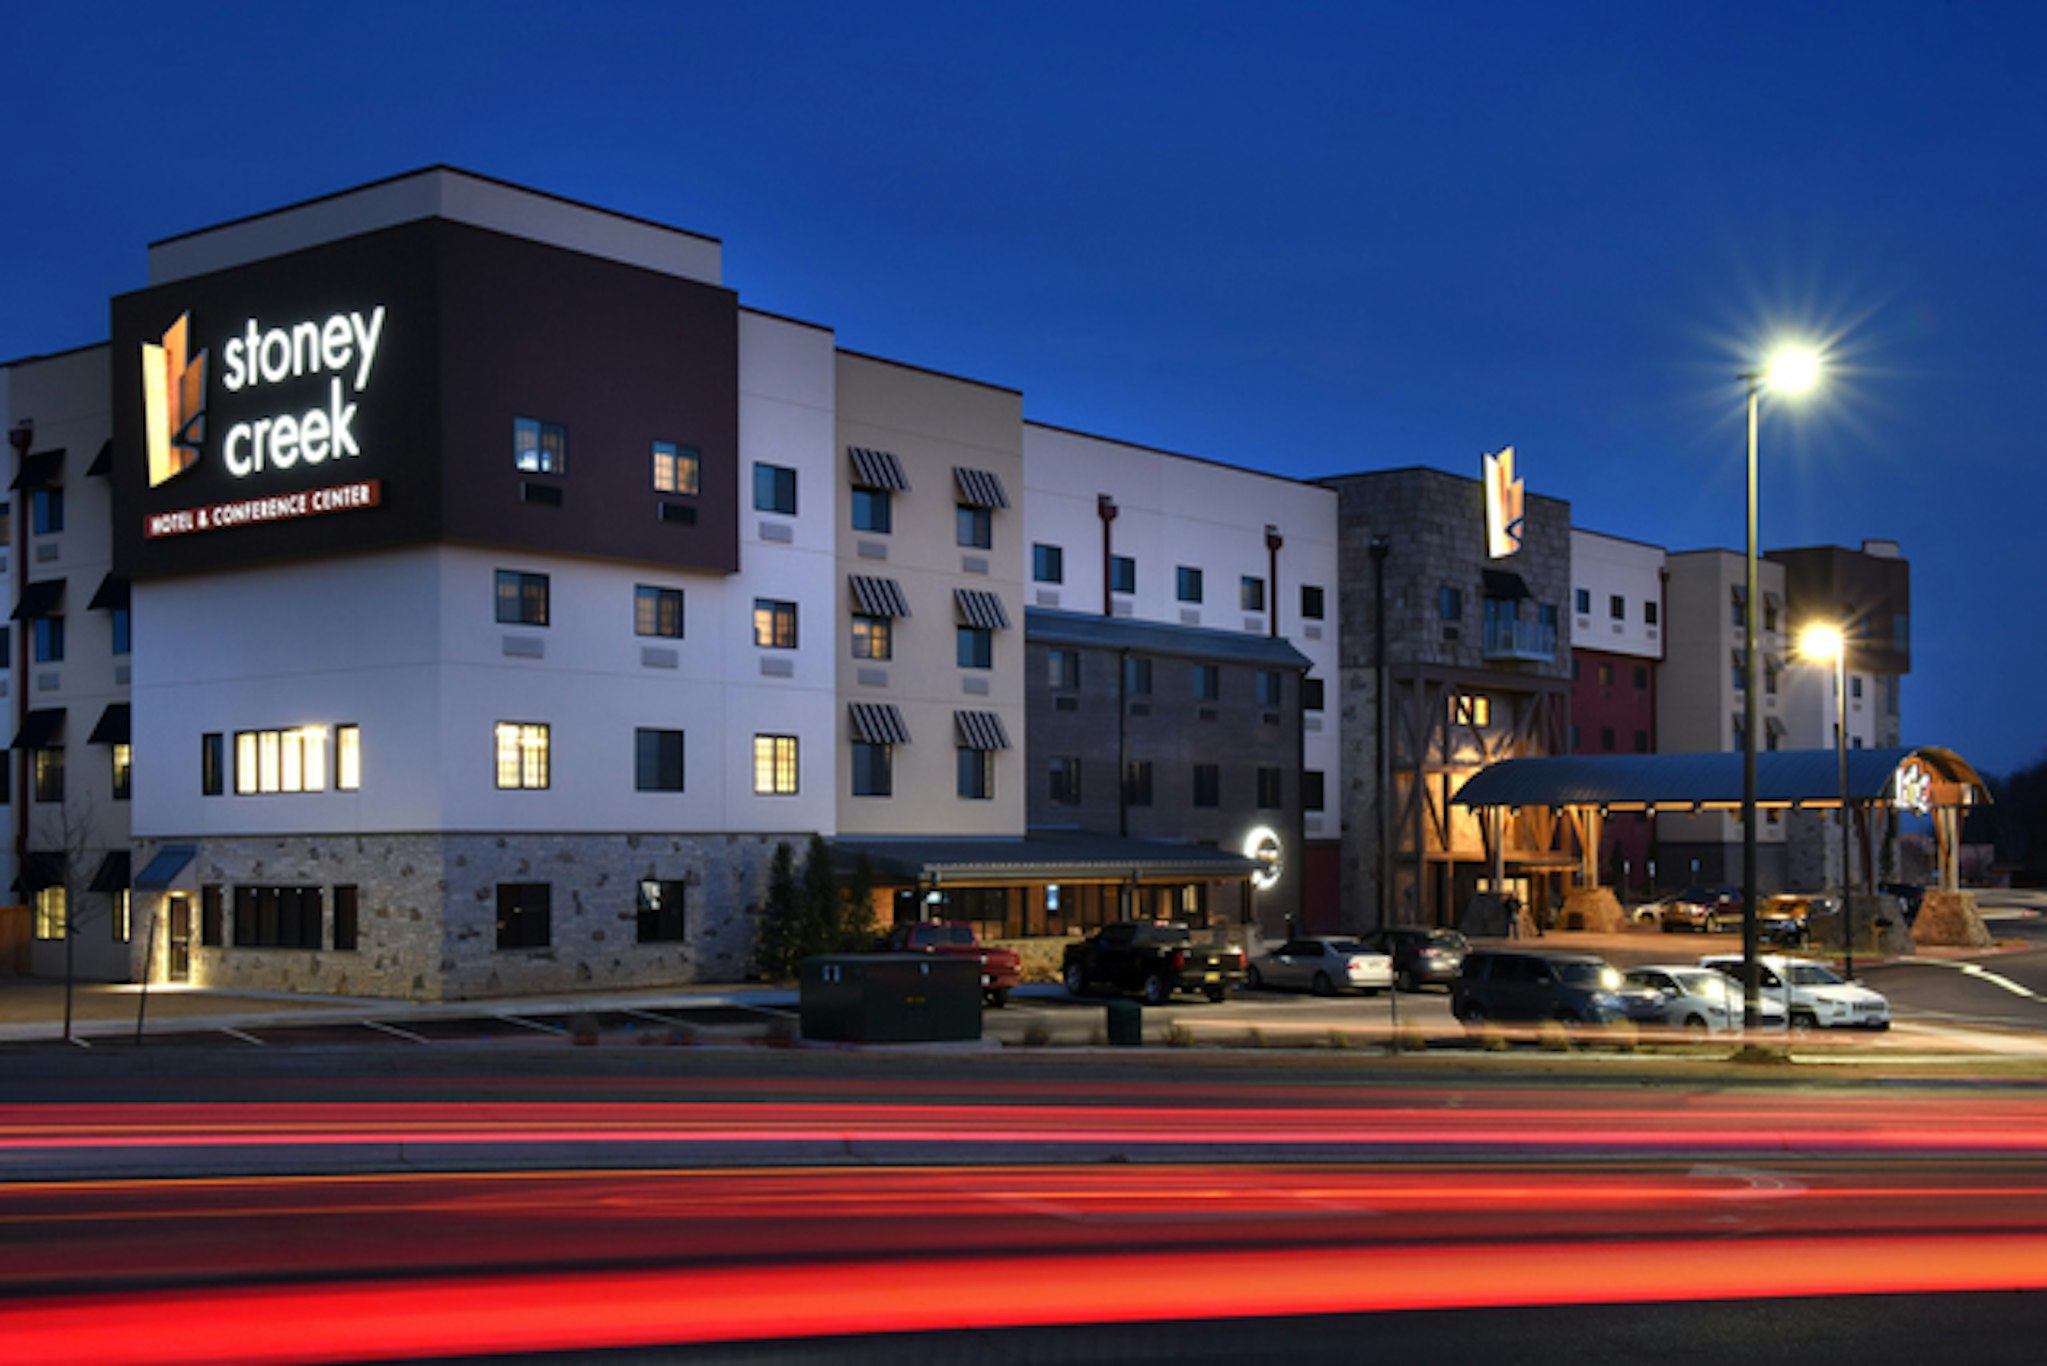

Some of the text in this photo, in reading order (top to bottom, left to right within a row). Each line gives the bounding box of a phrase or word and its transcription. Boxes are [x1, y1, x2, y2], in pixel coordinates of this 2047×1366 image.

[223, 305, 386, 391] stoney
[223, 376, 360, 477] creek
[151, 484, 370, 535] HOTEL & CONFERENCE CENTER
